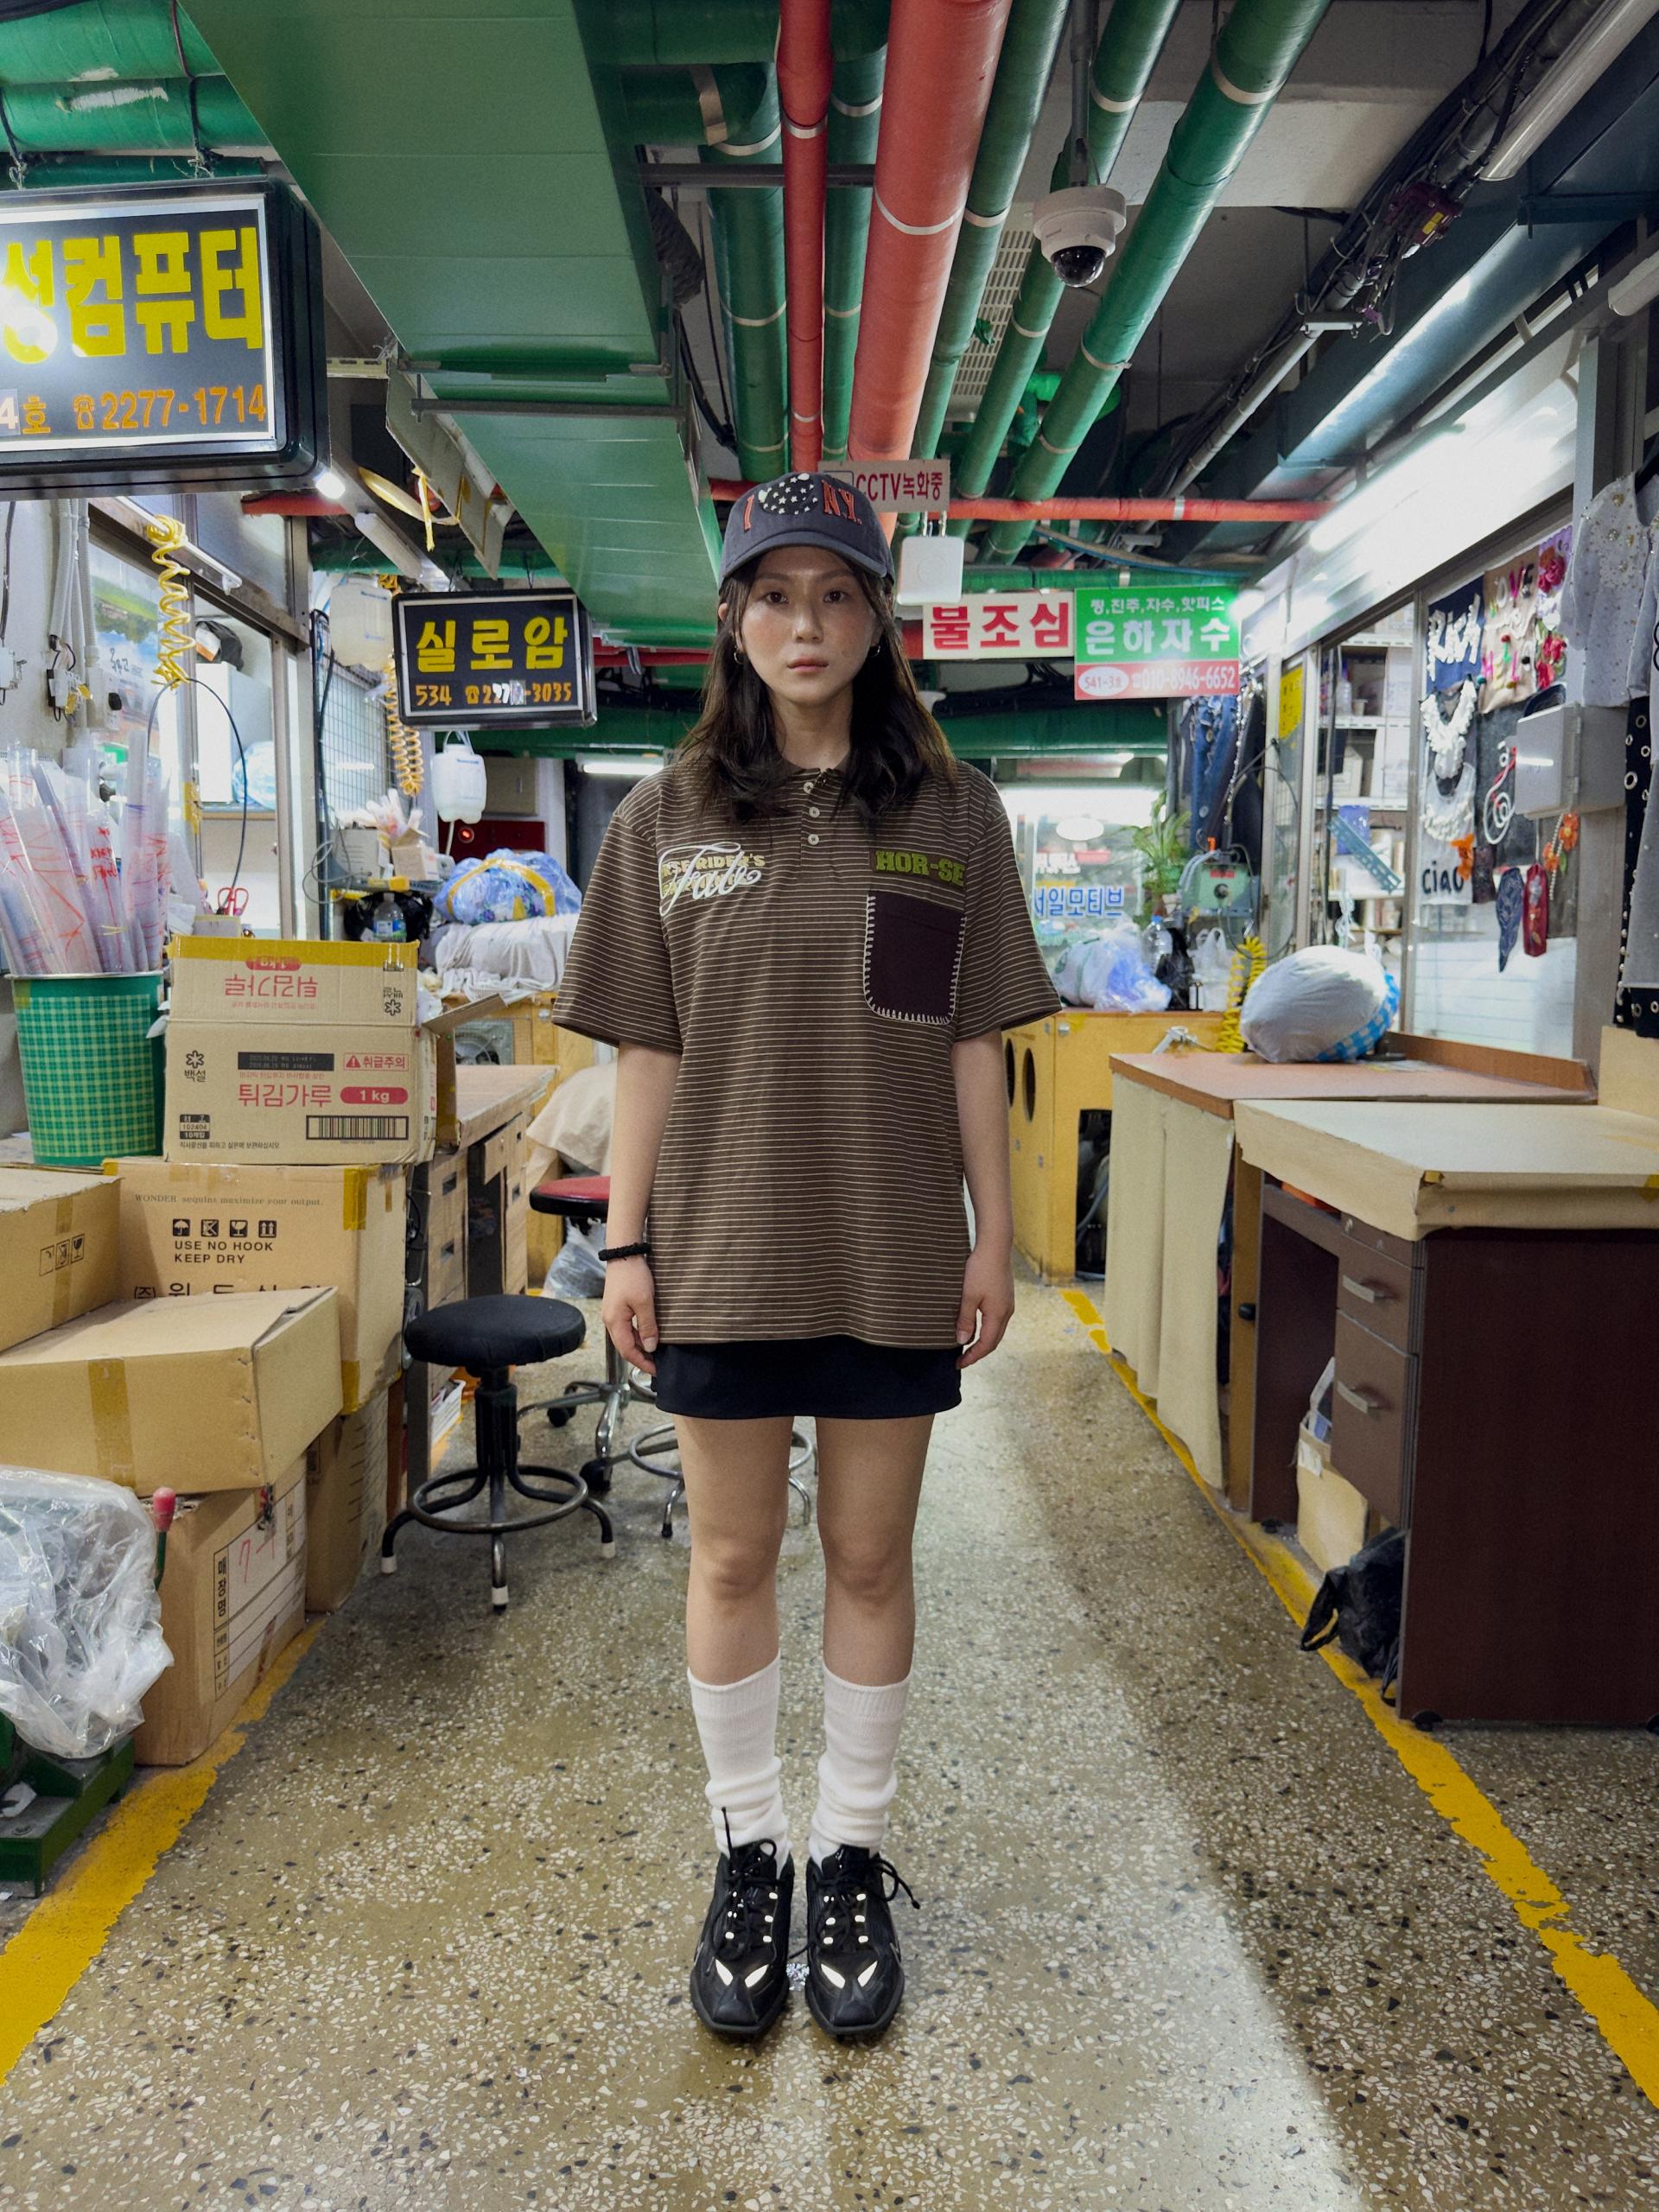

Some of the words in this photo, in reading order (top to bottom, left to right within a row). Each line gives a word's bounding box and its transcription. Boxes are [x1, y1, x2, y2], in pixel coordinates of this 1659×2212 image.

[100, 384, 267, 429] 2277-1714
[931, 601, 1069, 650] 불조심
[1085, 617, 1231, 656] 은하자수
[416, 615, 569, 673] 실로암
[416, 684, 452, 707] 534
[874, 850, 965, 887] HOR-SE
[225, 973, 319, 998] 튀김가루
[363, 1056, 406, 1069] 취급주의
[184, 1069, 207, 1082] 백설
[238, 1084, 333, 1108] 튀김가루
[372, 1090, 390, 1103] kg
[135, 1194, 177, 1204] WONDER
[175, 1241, 202, 1250] USE
[207, 1242, 227, 1251] NO
[233, 1242, 274, 1252] HOOK
[175, 1254, 211, 1263] KEEP
[217, 1254, 246, 1264] DRY
